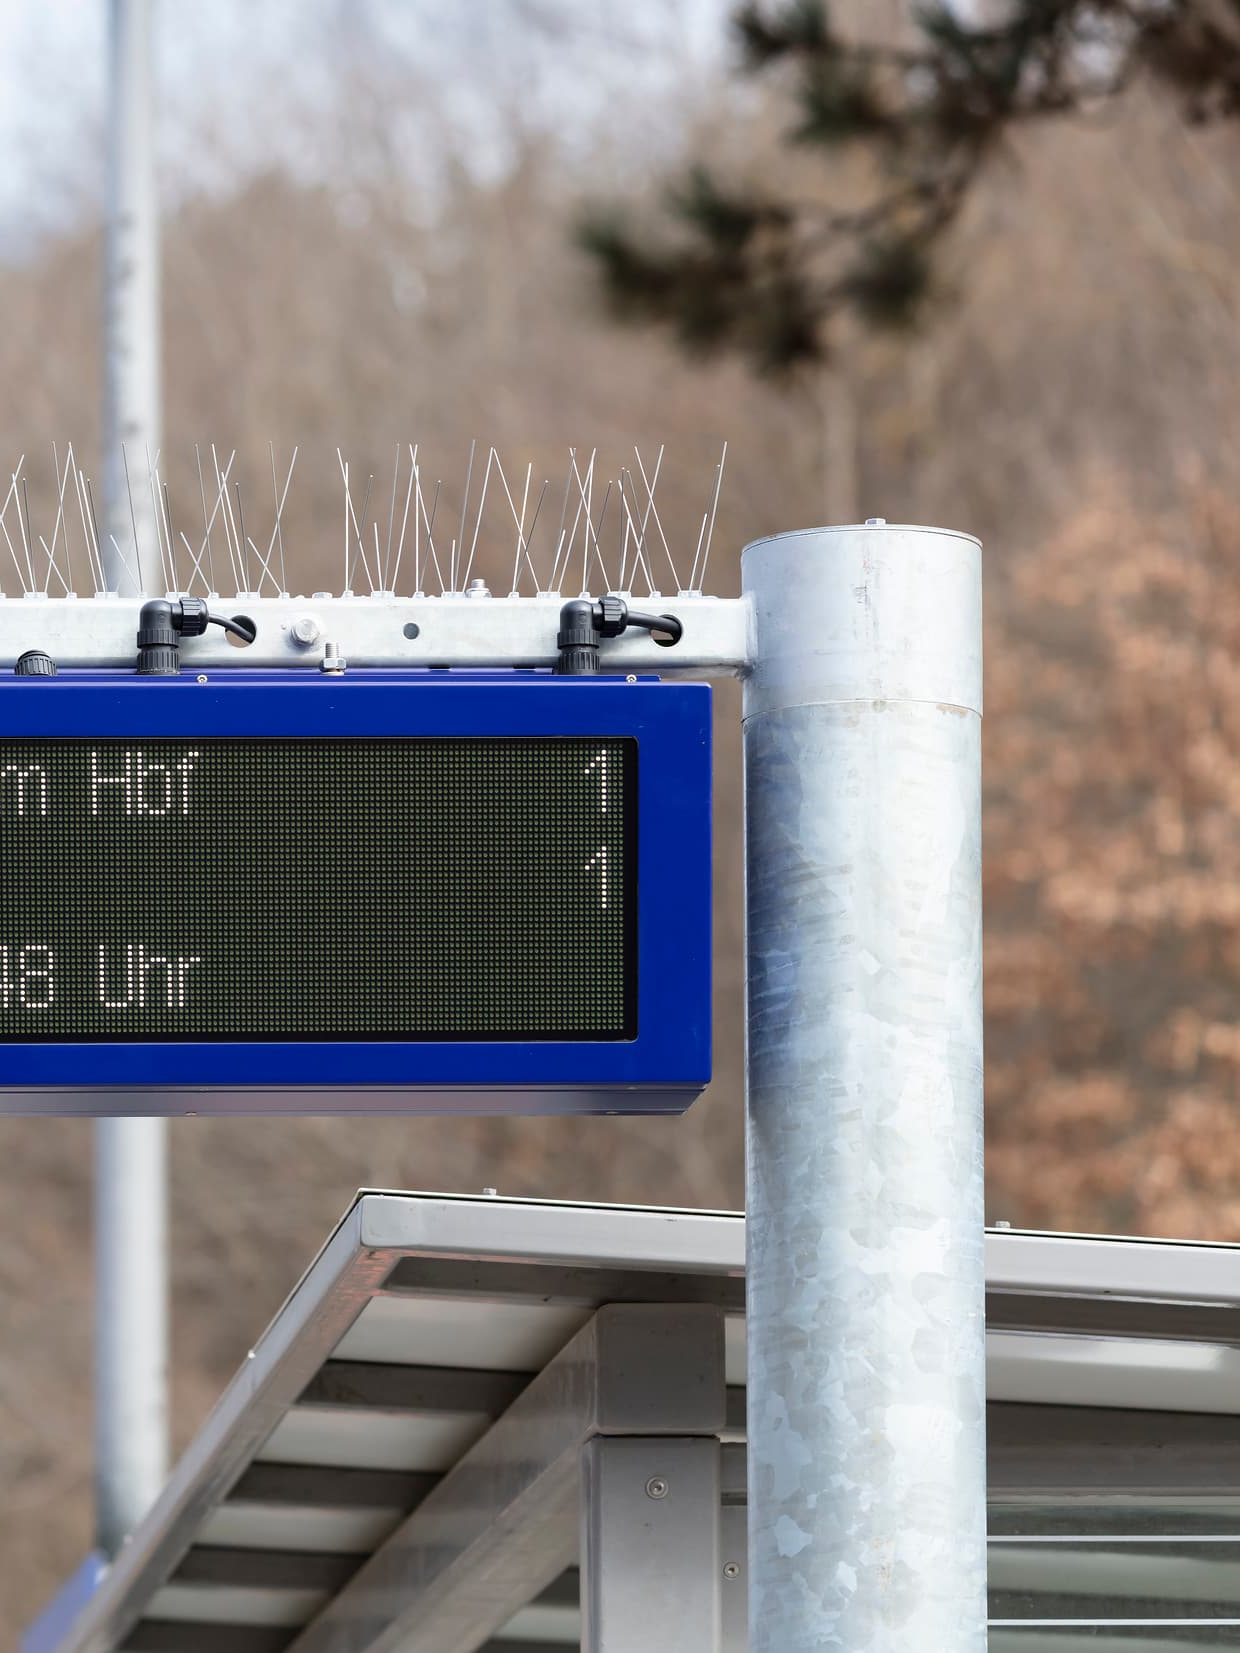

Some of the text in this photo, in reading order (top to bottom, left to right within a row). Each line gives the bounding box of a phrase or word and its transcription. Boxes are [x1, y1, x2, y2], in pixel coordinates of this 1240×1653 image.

[91, 751, 199, 816] Hbf
[584, 748, 608, 813] 1
[584, 846, 608, 910] 1
[98, 943, 201, 1009] Uhr
